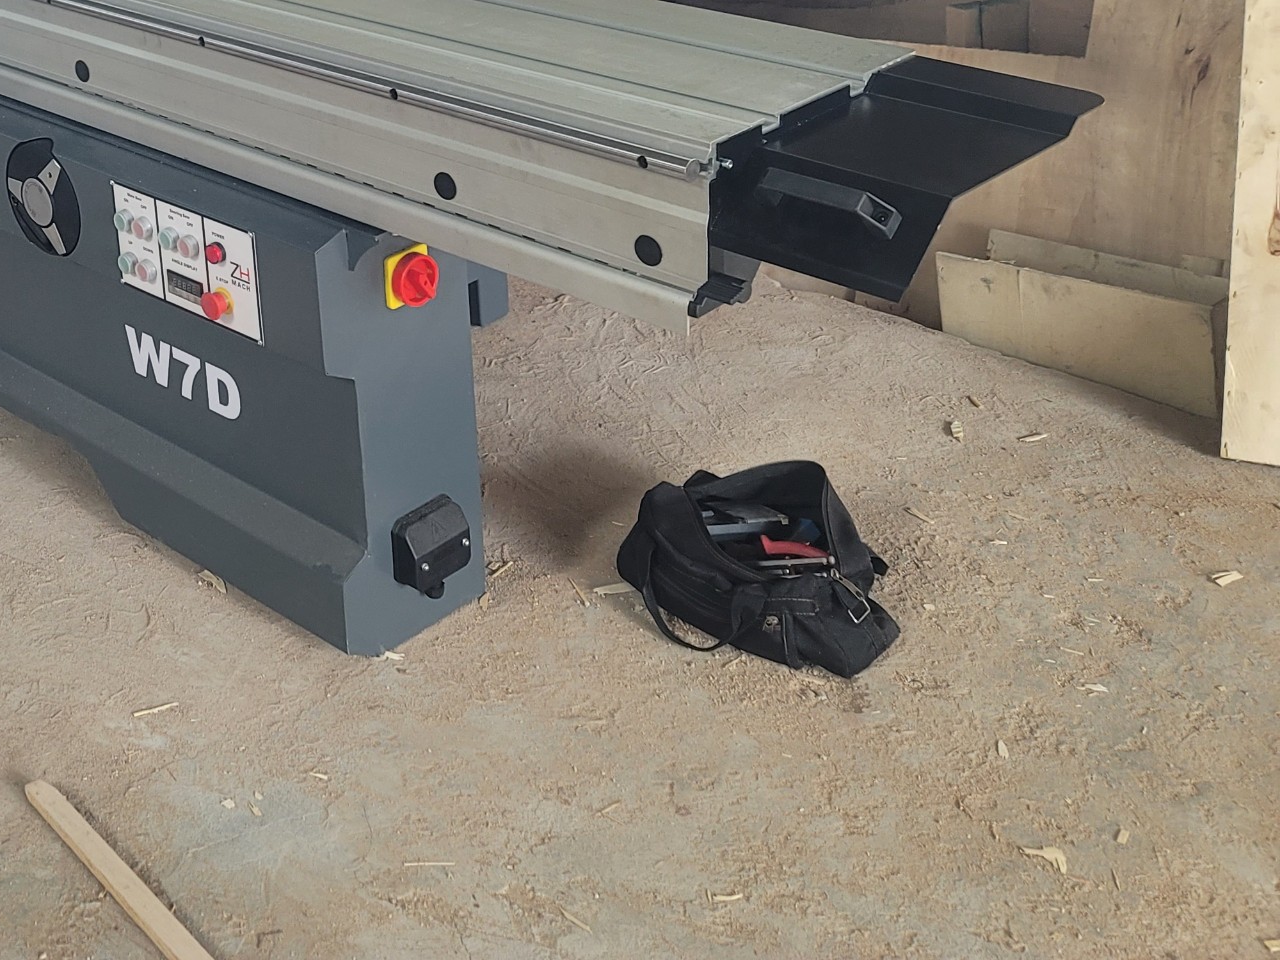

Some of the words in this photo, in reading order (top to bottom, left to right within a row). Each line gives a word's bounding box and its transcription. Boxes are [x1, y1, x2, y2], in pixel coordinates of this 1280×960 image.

[211, 231, 225, 240] POWER
[142, 246, 154, 254] DOWN
[183, 262, 198, 272] DISPLAY
[230, 260, 250, 284] ZH
[231, 278, 251, 292] MACH
[124, 323, 242, 420] W7D
